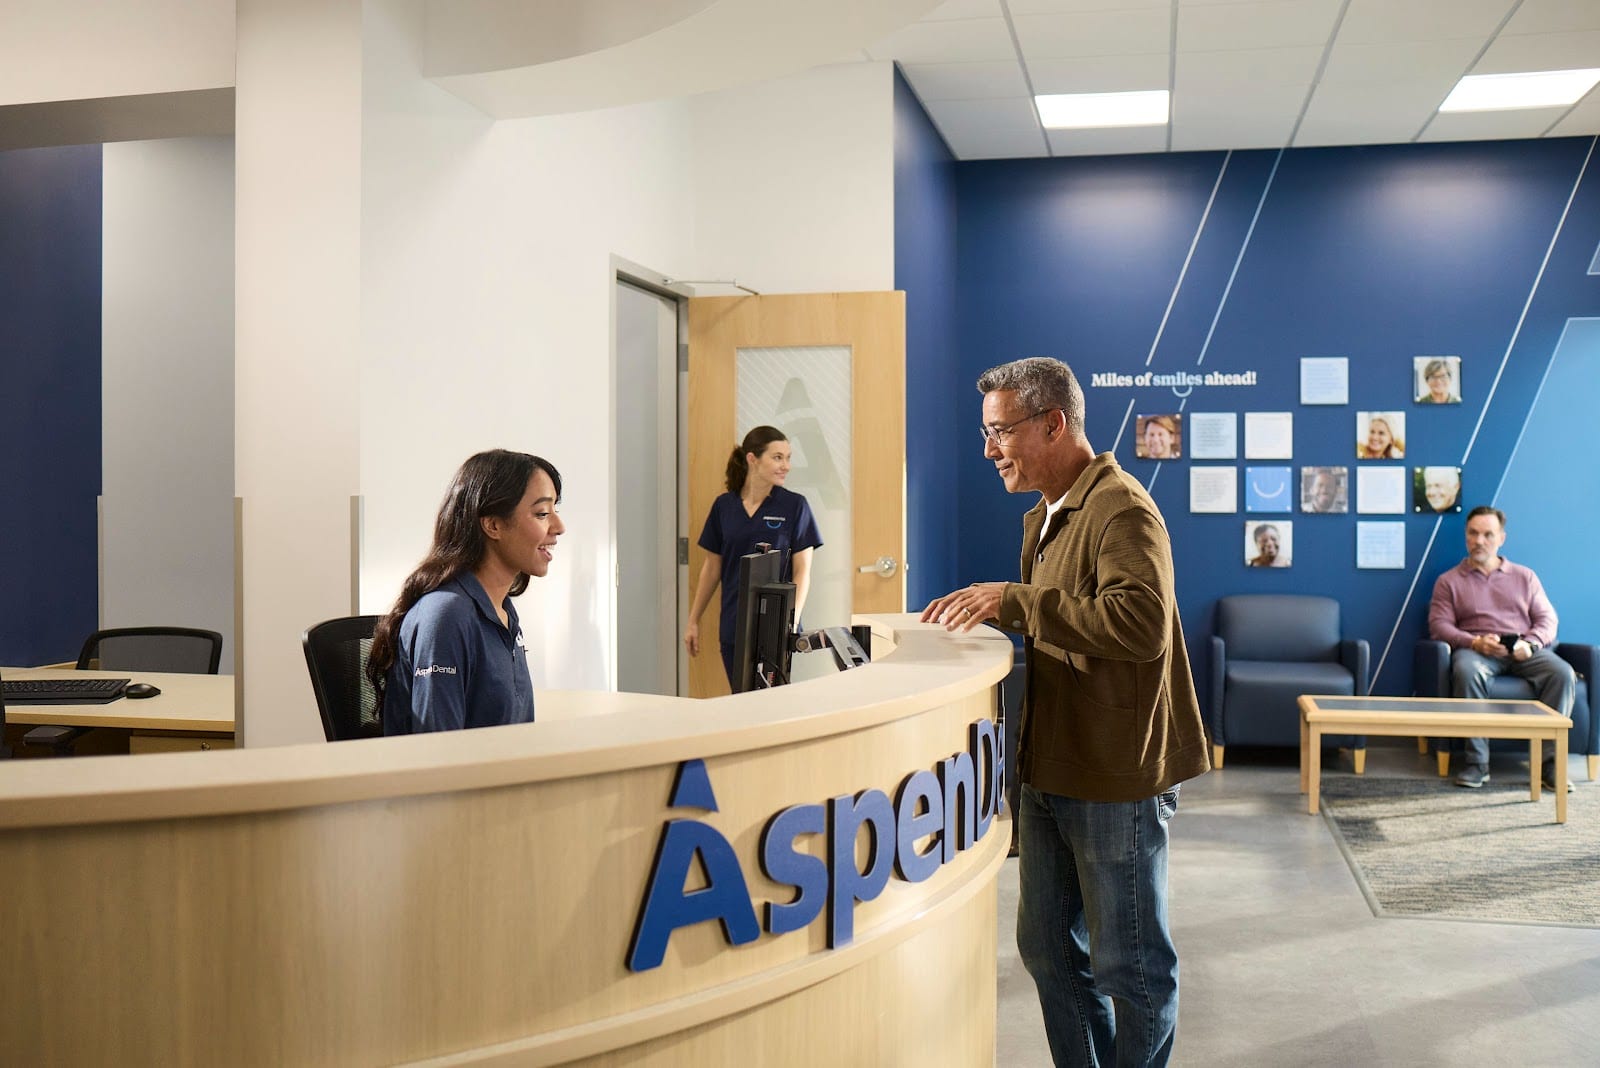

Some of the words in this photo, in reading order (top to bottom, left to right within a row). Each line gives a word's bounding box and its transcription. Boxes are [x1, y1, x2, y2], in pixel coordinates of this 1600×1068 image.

[1091, 373, 1133, 387] Miles
[1135, 372, 1153, 387] of
[1153, 371, 1203, 387] smiles
[1204, 371, 1257, 386] ahead!
